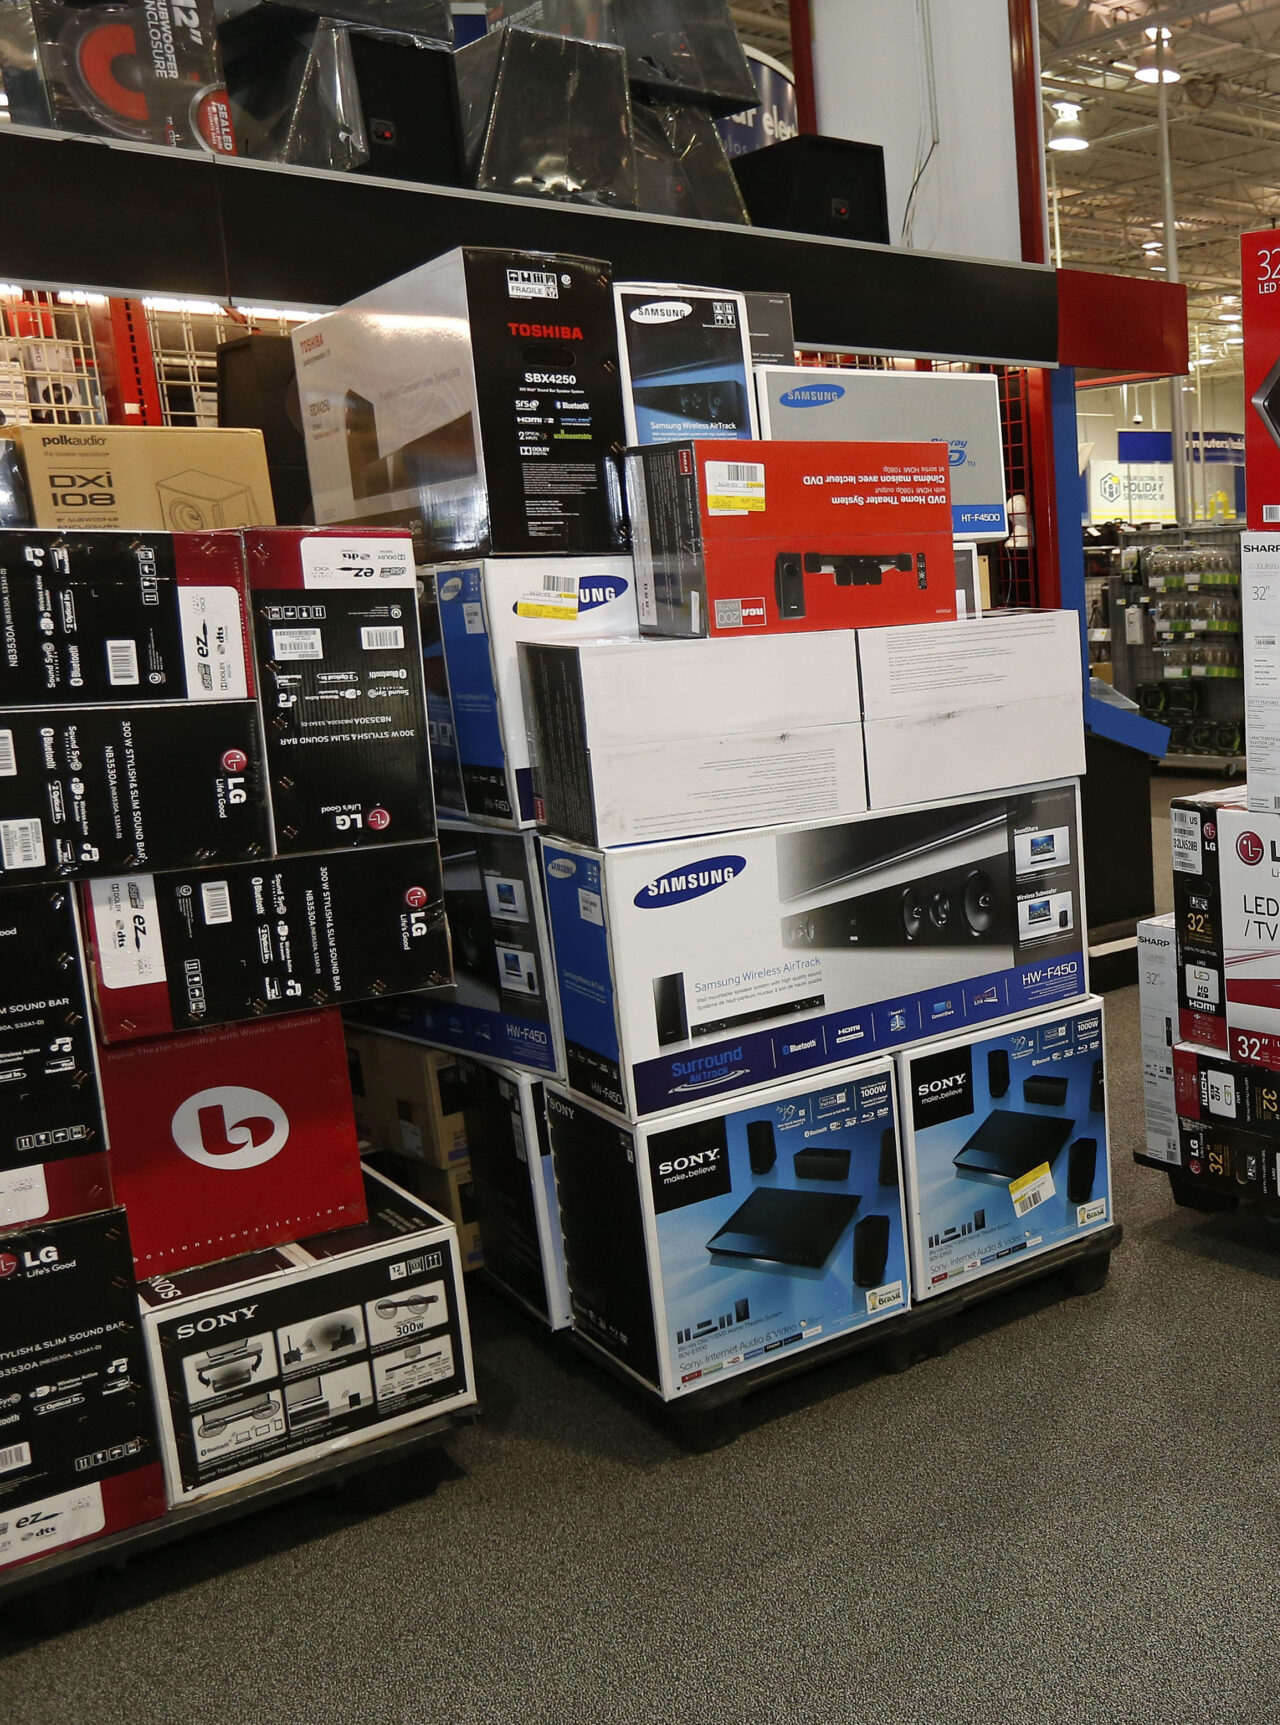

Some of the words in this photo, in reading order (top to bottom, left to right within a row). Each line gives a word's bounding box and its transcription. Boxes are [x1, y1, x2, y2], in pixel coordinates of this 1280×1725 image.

[217, 103, 233, 151] SEALED
[511, 285, 543, 295] FRAGILE
[1259, 282, 1277, 294] LED
[638, 307, 686, 319] SAMSUNG
[508, 322, 584, 340] TOSHIBA
[300, 334, 324, 354] TOSHIBA
[524, 373, 577, 385] SBX4250
[787, 388, 838, 401] SAMSUNG
[650, 421, 681, 431] Samsung
[682, 422, 709, 430] Wireless
[709, 421, 737, 430] AirTrack
[42, 434, 107, 447] polkaudio
[49, 471, 113, 488] DXi
[803, 475, 823, 485] DVD
[825, 475, 856, 484] lecteur
[880, 475, 912, 484] maison
[913, 475, 945, 485] Cinéma
[1123, 482, 1164, 492] HOLIDAY
[52, 493, 116, 507] 108
[831, 496, 864, 505] System
[866, 496, 899, 504] Theater
[901, 496, 926, 504] Home
[927, 495, 946, 504] DVD
[961, 513, 1001, 522] HT-F4500
[6, 625, 19, 667] NB3530A
[69, 645, 81, 678] Bluetooth
[122, 720, 131, 738] 300
[353, 715, 392, 725] NB3530A
[280, 737, 298, 745] BAR
[300, 735, 329, 744] SOUND
[331, 734, 350, 742] SLIM
[358, 731, 389, 739] STYLISH
[400, 729, 415, 738] 300
[43, 737, 57, 769] Bluetooth
[104, 745, 117, 786] NB3530A
[126, 748, 137, 783] STYLISH
[130, 789, 140, 809] SLIM
[227, 777, 247, 804] LG
[216, 799, 227, 819] Good
[321, 804, 341, 813] Good
[133, 810, 144, 840] SOUND
[335, 813, 363, 830] LG
[1189, 816, 1198, 825] US
[136, 841, 146, 859] BAR
[1204, 841, 1216, 851] LG
[320, 866, 328, 882] 300
[647, 865, 735, 898] SAMSUNG
[305, 889, 316, 927] NB3530A
[323, 891, 333, 923] STYLISH
[1243, 894, 1280, 917] LED
[410, 911, 428, 938] LG
[1186, 913, 1209, 933] 32"
[1256, 920, 1279, 942] TV
[327, 928, 336, 946] SLIM
[1138, 935, 1171, 948] SHARP
[330, 947, 340, 974] SOUND
[694, 975, 741, 993] Samsung
[742, 965, 782, 981] Wireless
[782, 956, 822, 973] AirTrack
[1022, 961, 1078, 985] HW-F450
[333, 975, 341, 991] BAR
[10, 1000, 46, 1013] SOUND
[48, 998, 70, 1009] BAR
[1188, 1000, 1216, 1012] HDMI
[506, 1023, 547, 1045] HW-F450
[837, 1024, 861, 1035] HDMI
[1077, 1019, 1099, 1032] 1000W
[138, 1044, 174, 1056] Theater
[174, 1035, 218, 1049] Soundbar
[219, 1031, 240, 1041] with
[790, 1040, 817, 1053] Bluetooth
[1236, 1035, 1269, 1062] 32"
[671, 1046, 743, 1078] Surround
[689, 1065, 730, 1084] AirTrack
[861, 1084, 887, 1098] 1000W
[918, 1072, 966, 1097] SONY
[1200, 1071, 1208, 1106] HDMI
[921, 1087, 963, 1105] make.believe
[549, 1100, 575, 1120] SONY
[1190, 1138, 1199, 1157] LG
[658, 1147, 720, 1176] SONY
[663, 1164, 717, 1185] make.believe
[1086, 1208, 1105, 1220] Brasil
[977, 1243, 996, 1256] Audio
[1004, 1233, 1023, 1246] Video
[23, 1245, 59, 1268] LG
[27, 1266, 51, 1278] Life's
[52, 1260, 77, 1272] Good
[878, 1293, 901, 1306] Brasil
[176, 1303, 259, 1340] SONY
[43, 1337, 67, 1349] SLIM
[69, 1326, 104, 1342] SOUND
[105, 1321, 125, 1332] BAR
[705, 1347, 738, 1364] Internet
[739, 1336, 764, 1352] Audio
[773, 1324, 797, 1338] Video
